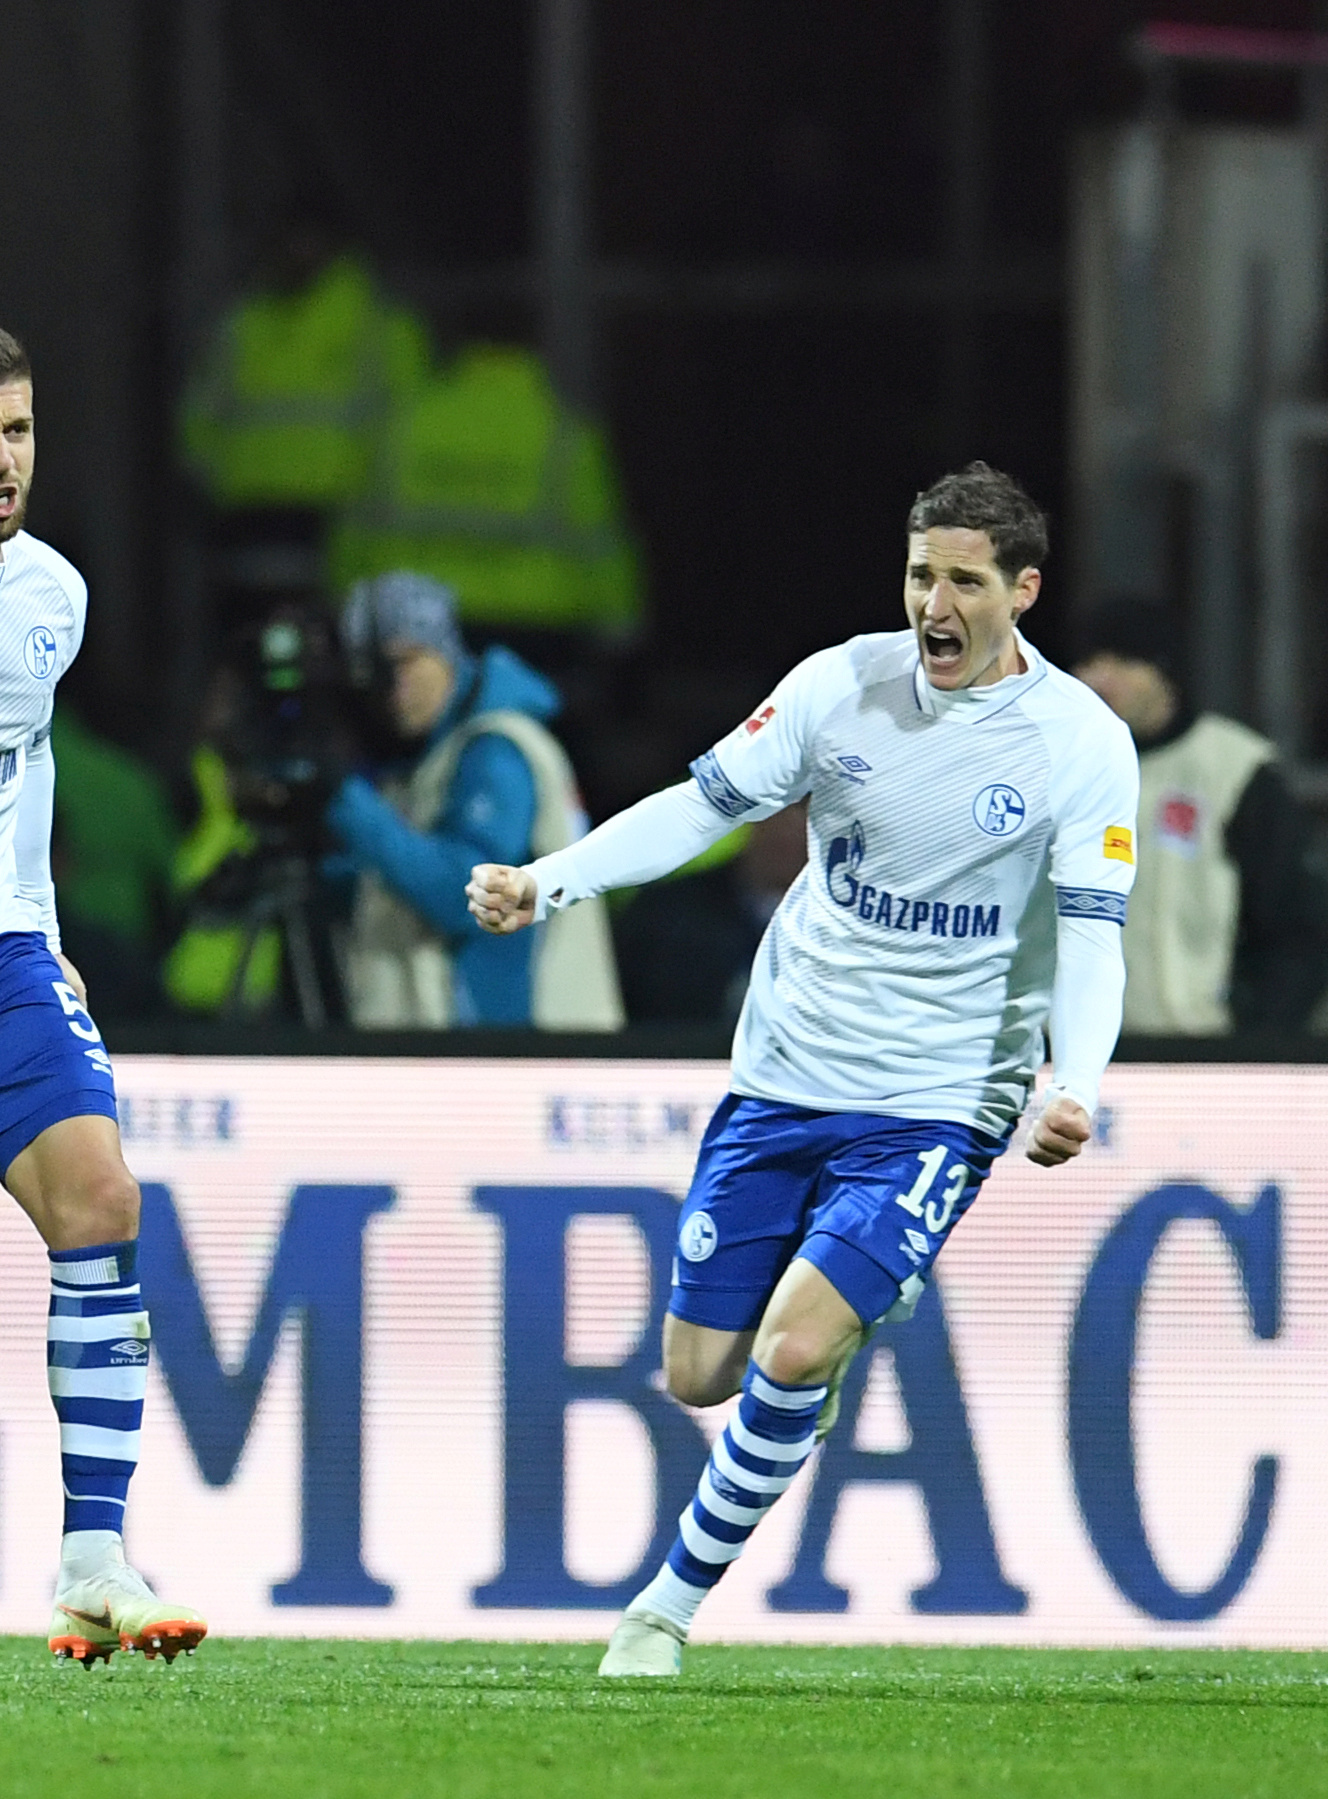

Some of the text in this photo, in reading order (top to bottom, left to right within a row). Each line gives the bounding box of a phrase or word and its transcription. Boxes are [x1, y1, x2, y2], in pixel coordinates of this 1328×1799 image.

[859, 885, 1001, 938] GAZPROM
[51, 982, 102, 1043] 5
[895, 1144, 969, 1233] 13
